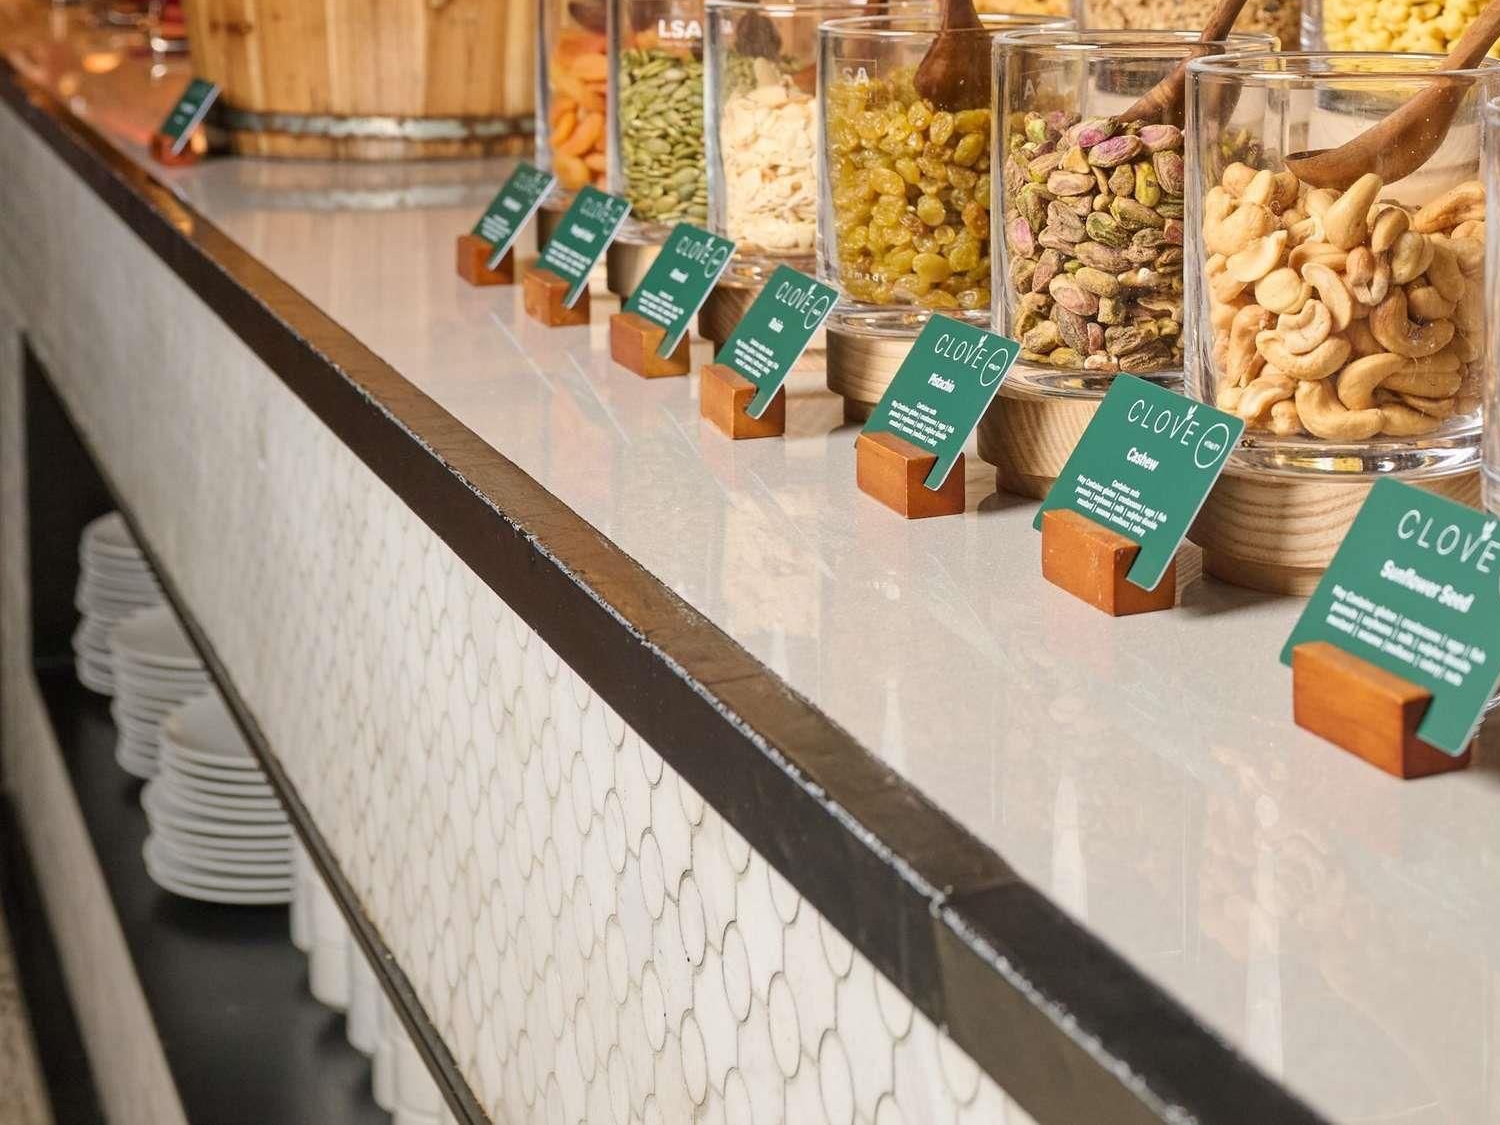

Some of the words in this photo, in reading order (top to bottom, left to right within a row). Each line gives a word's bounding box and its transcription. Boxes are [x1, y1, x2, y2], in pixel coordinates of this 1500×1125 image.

[657, 19, 702, 39] LSA
[775, 281, 815, 314] CLOVE
[934, 333, 988, 369] CLOVE
[1127, 399, 1200, 446] CLOVE
[1126, 447, 1160, 472] Cashew
